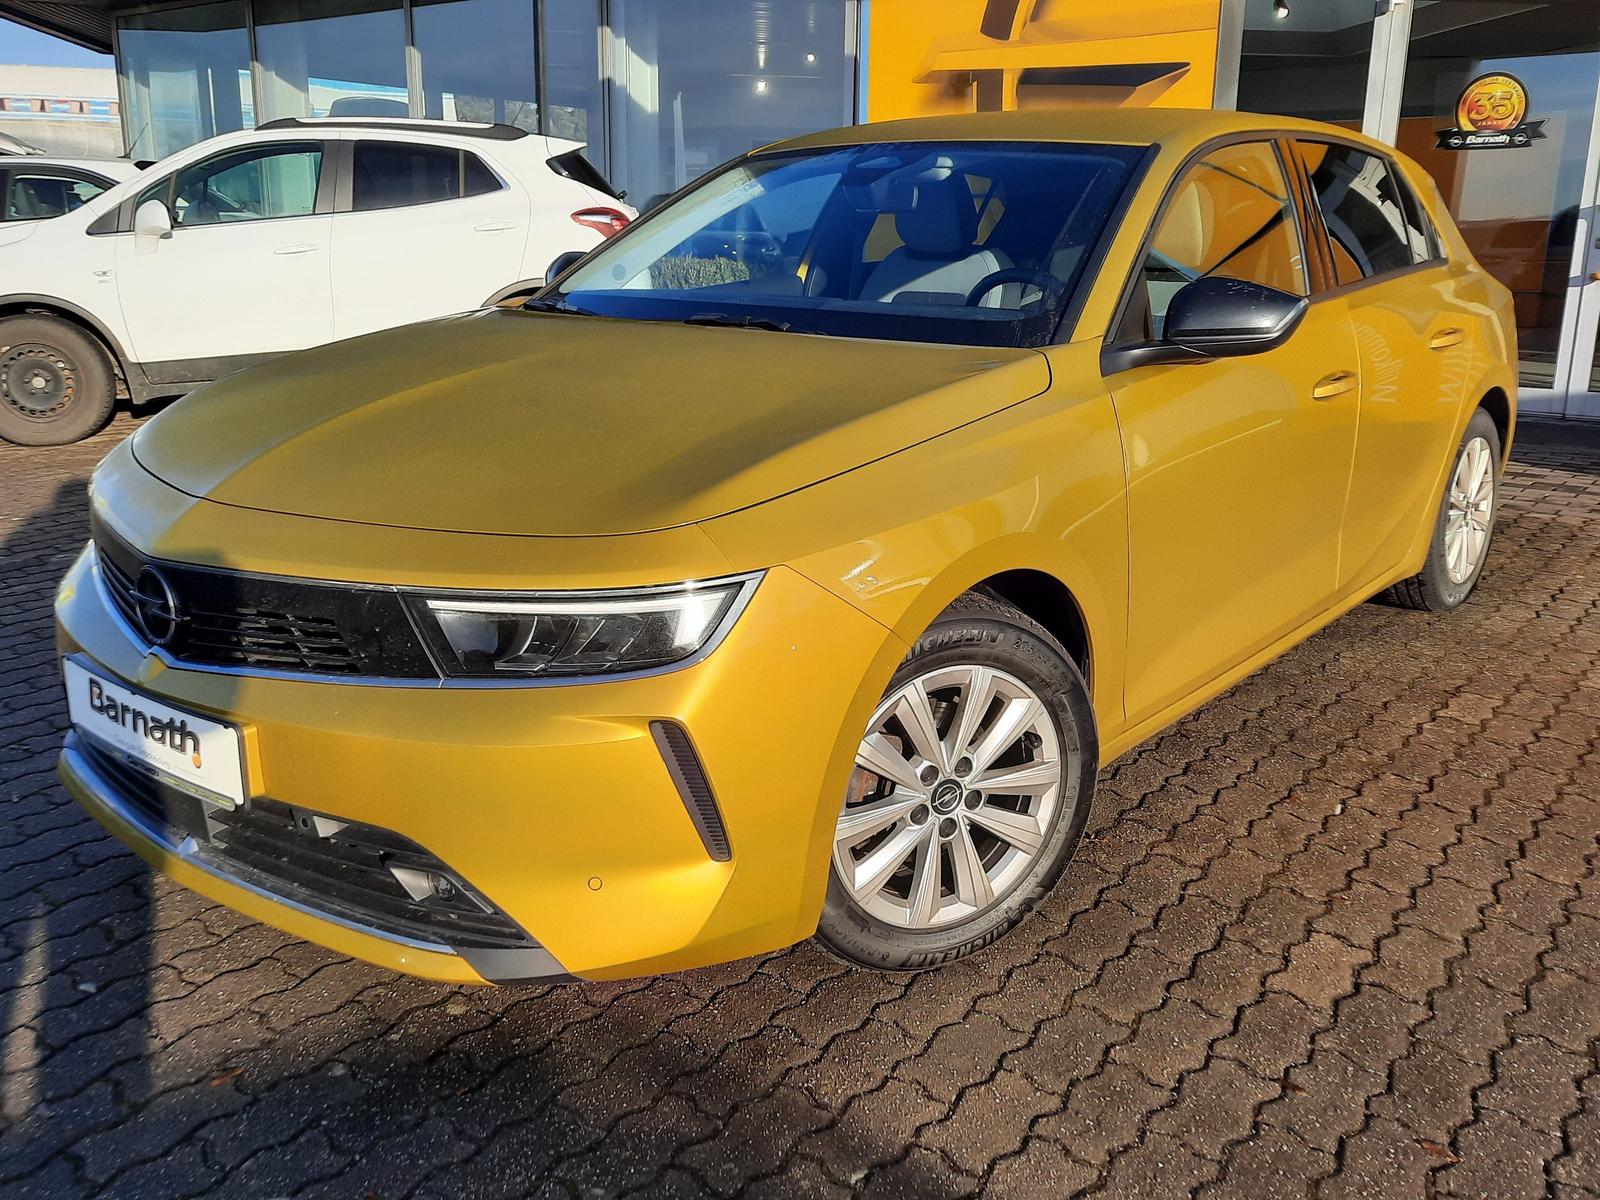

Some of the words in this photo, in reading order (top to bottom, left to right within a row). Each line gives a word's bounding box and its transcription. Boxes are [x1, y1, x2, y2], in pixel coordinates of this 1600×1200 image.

[1469, 91, 1514, 120] 35
[1465, 135, 1510, 144] Barnath
[89, 677, 202, 763] Barnath
[903, 919, 1009, 968] MICHELIN
